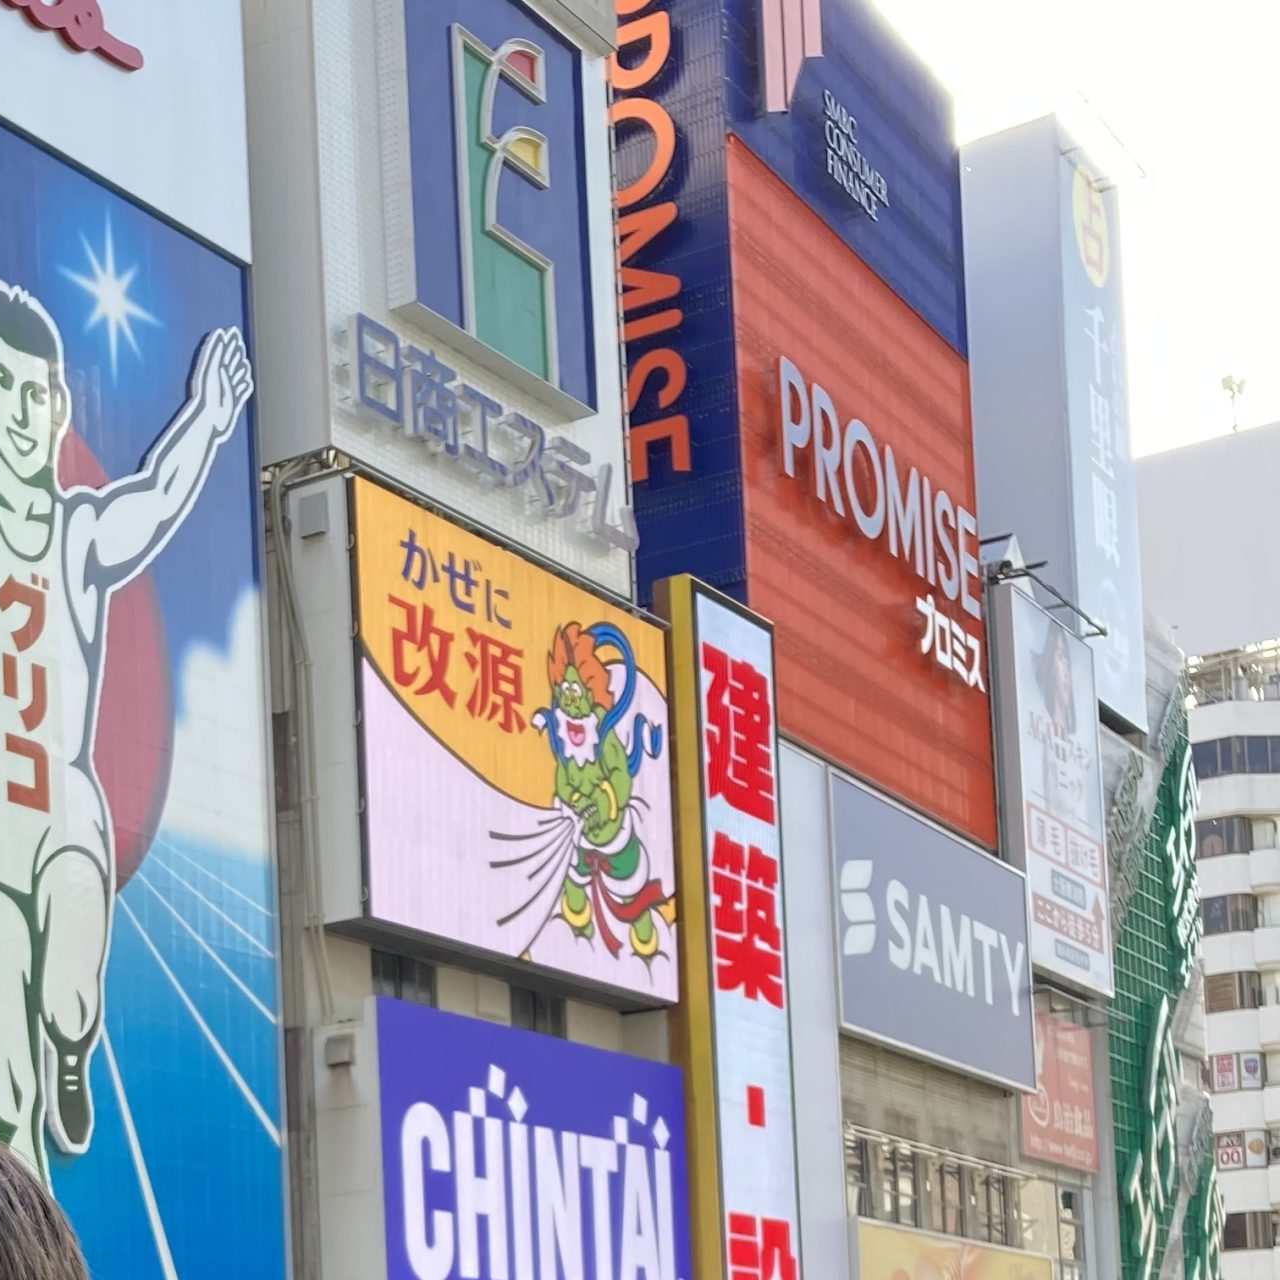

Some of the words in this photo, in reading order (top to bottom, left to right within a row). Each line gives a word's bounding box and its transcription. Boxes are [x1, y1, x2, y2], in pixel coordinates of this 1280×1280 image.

[824, 89, 858, 144] SMBC
[825, 120, 890, 207] CONSUMER
[827, 147, 879, 222] FINANCE
[348, 312, 640, 552] 日商エステム
[779, 355, 982, 621] PROMISE
[400, 528, 512, 630] かぜに
[388, 594, 526, 734] 改源
[915, 594, 986, 693] プロミス
[886, 878, 1024, 1017] SAMTY
